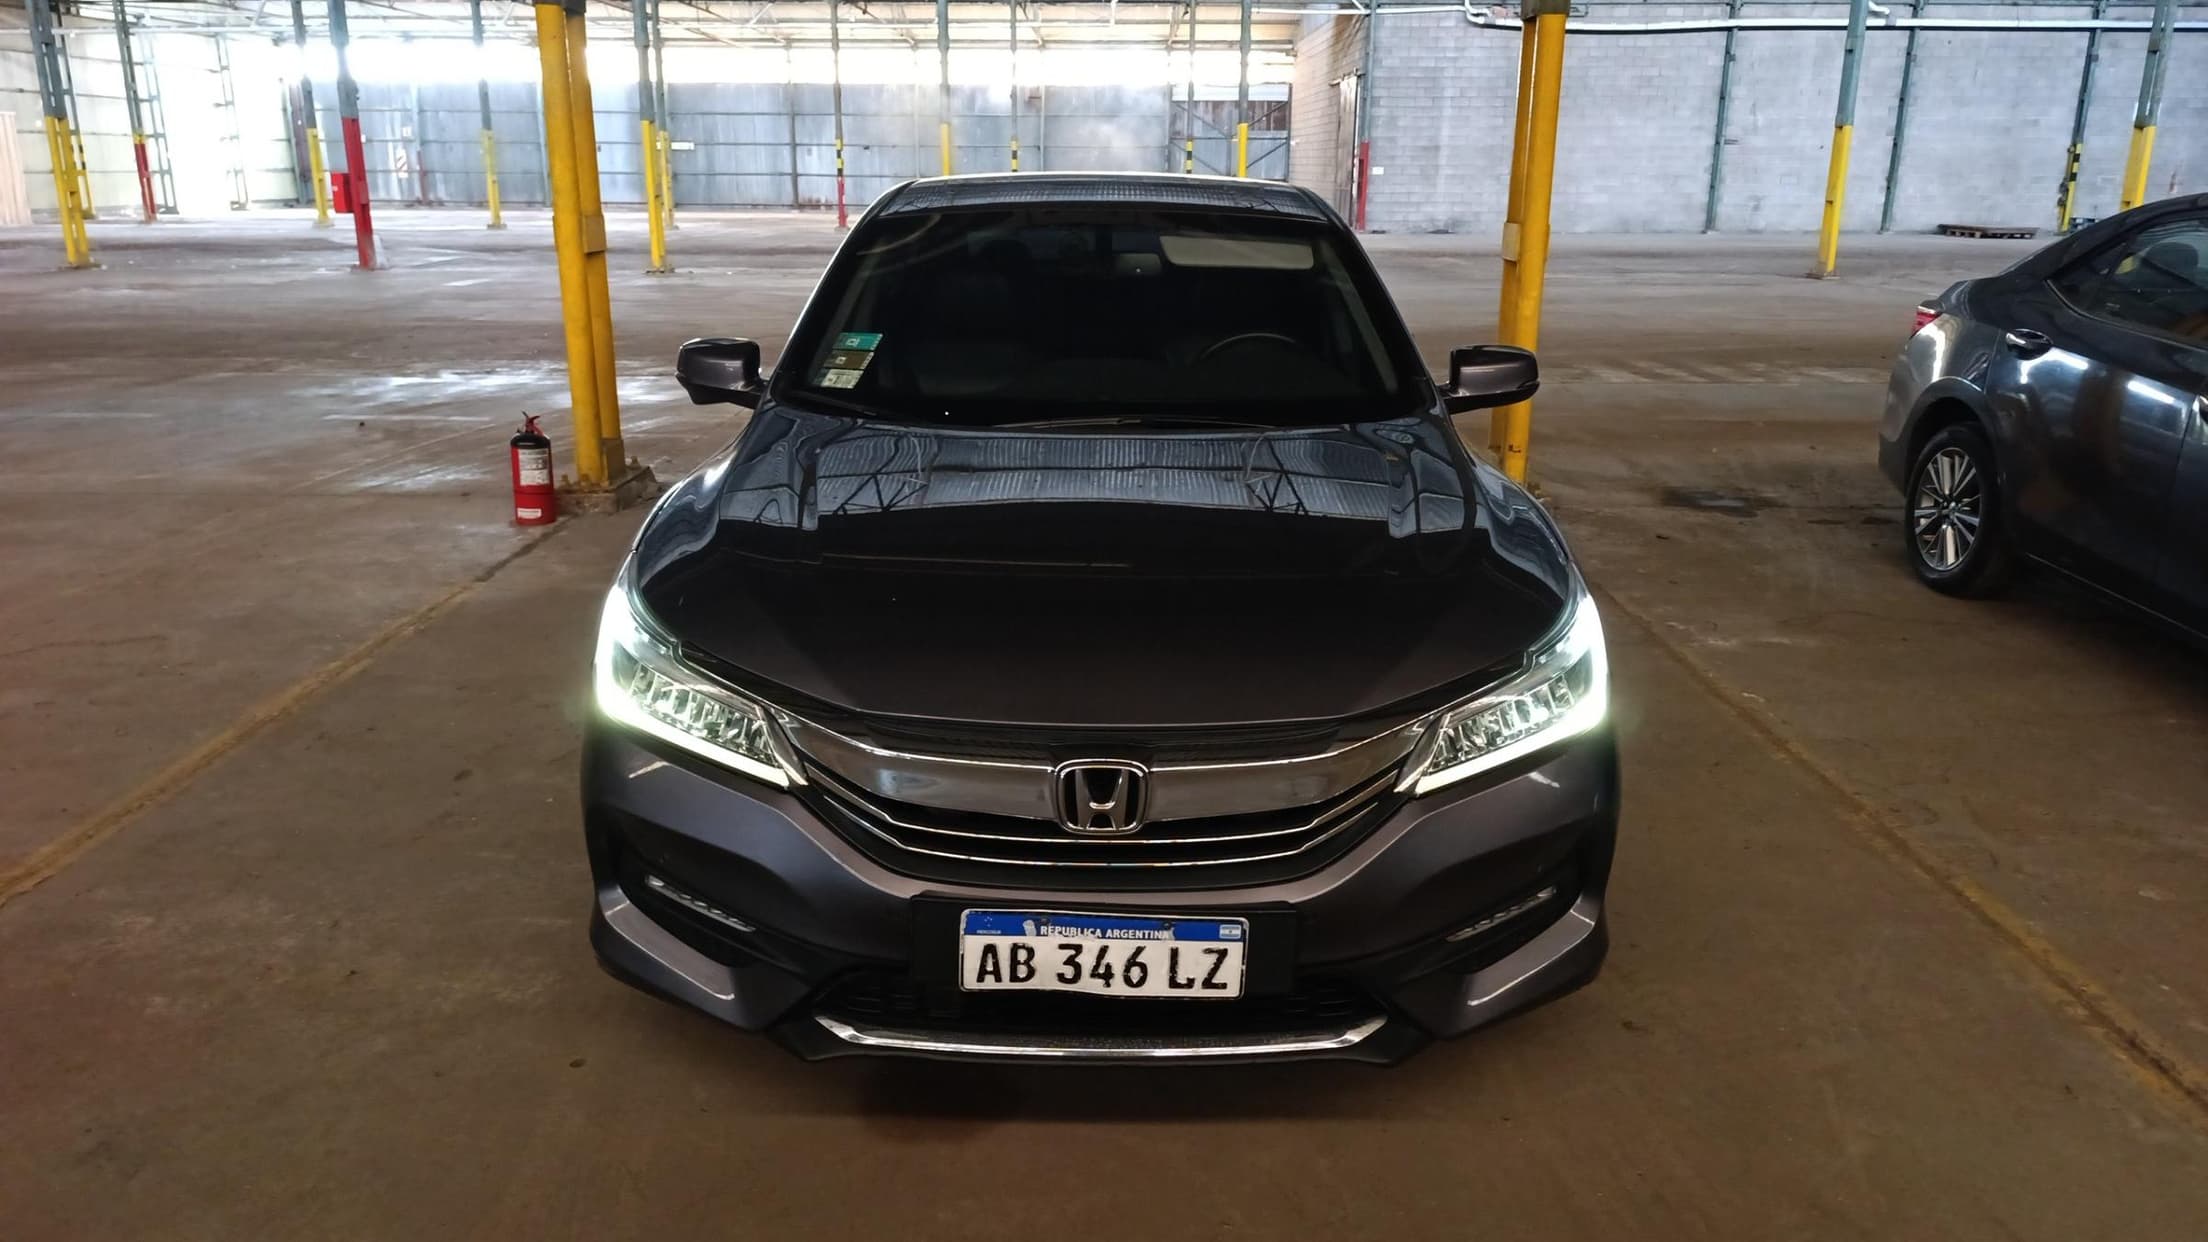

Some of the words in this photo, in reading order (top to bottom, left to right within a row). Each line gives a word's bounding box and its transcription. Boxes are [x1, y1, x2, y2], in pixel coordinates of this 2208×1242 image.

[976, 942, 1036, 983] AB
[1056, 943, 1148, 988] 346
[1169, 947, 1229, 989] LZ
